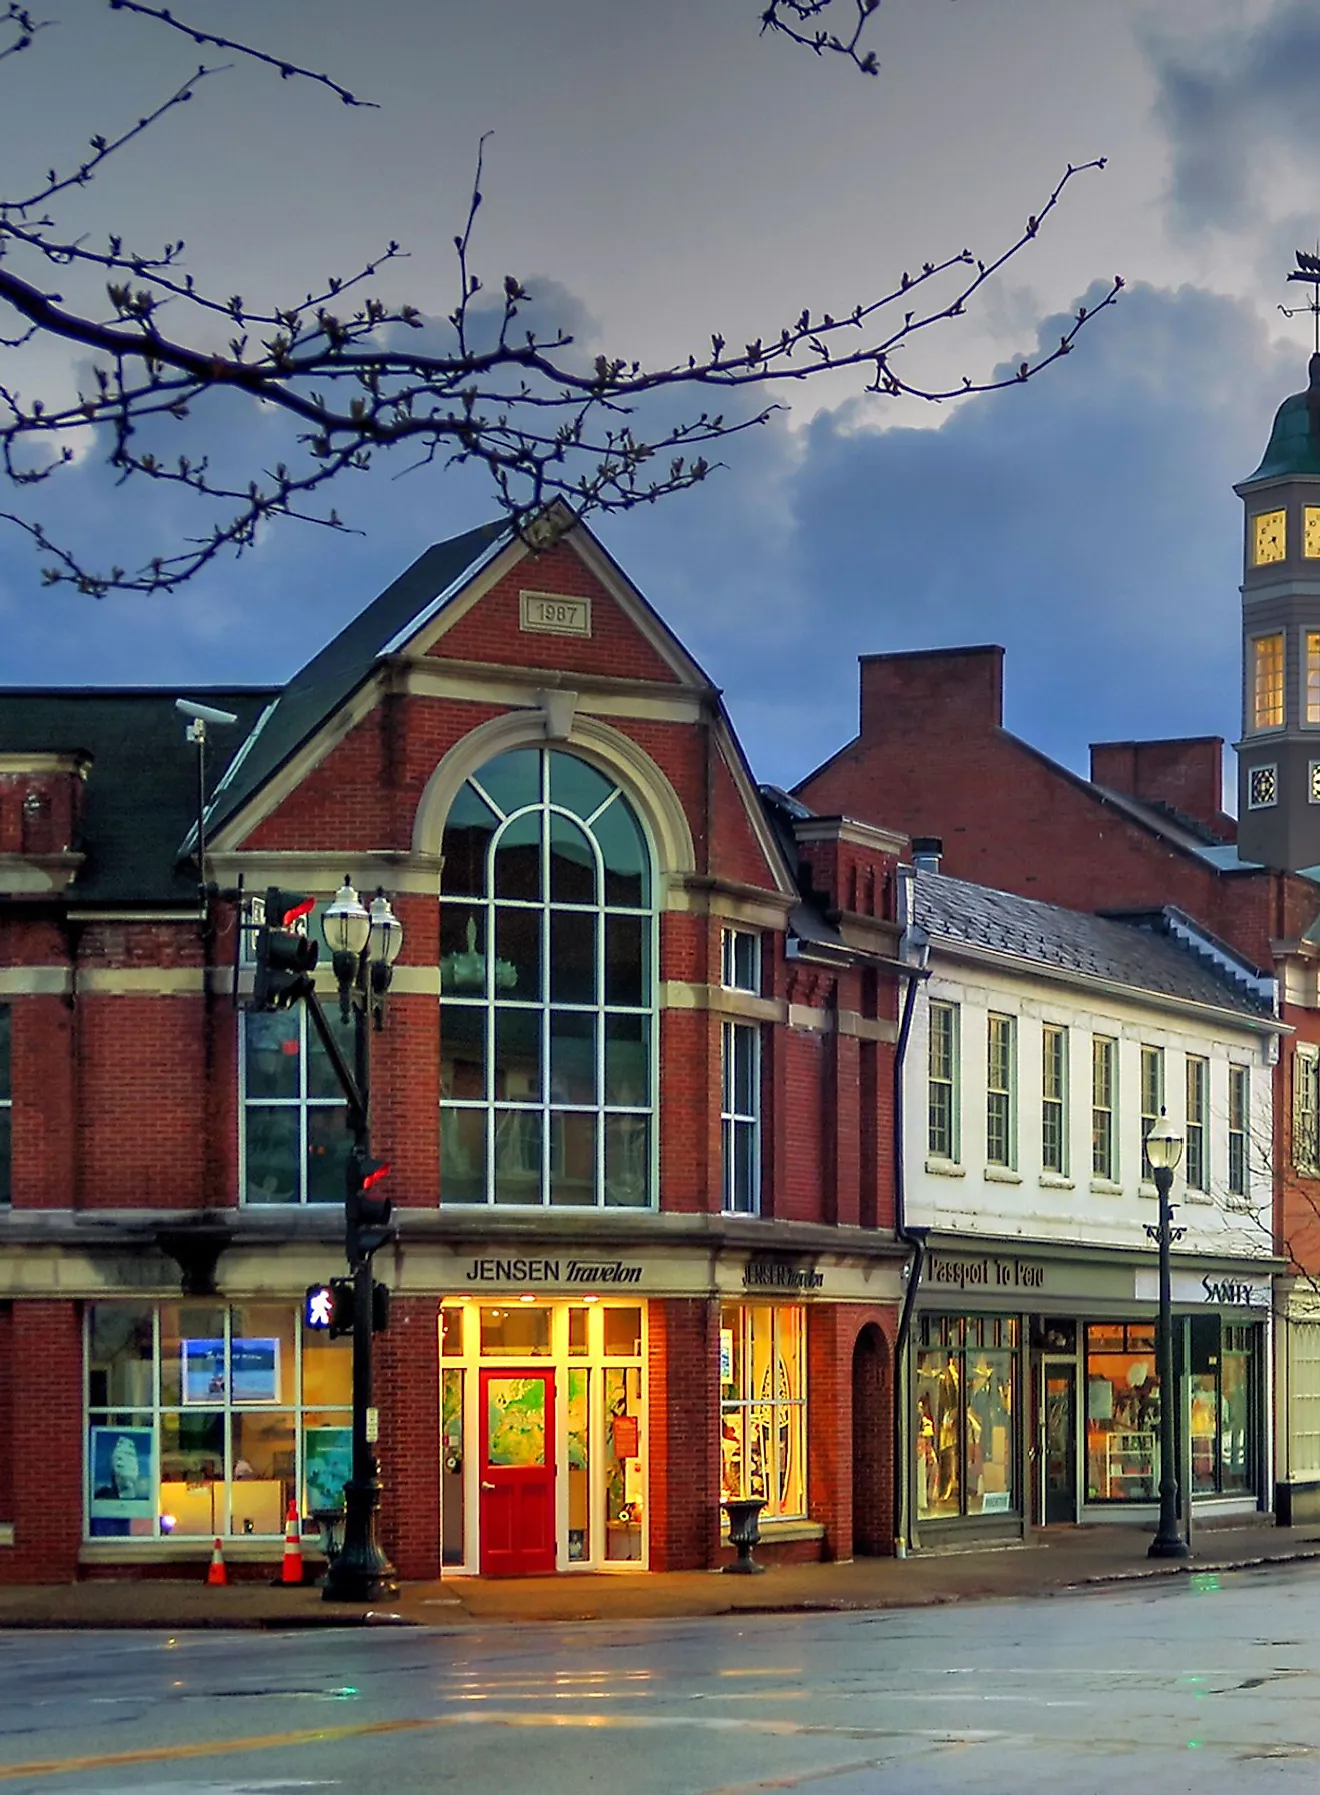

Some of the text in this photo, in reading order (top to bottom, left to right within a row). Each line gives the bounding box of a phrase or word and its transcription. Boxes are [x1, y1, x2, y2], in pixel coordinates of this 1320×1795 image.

[537, 603, 577, 624] 1987
[466, 1259, 643, 1283] JENSEN Travelon
[928, 1254, 989, 1289] Passport
